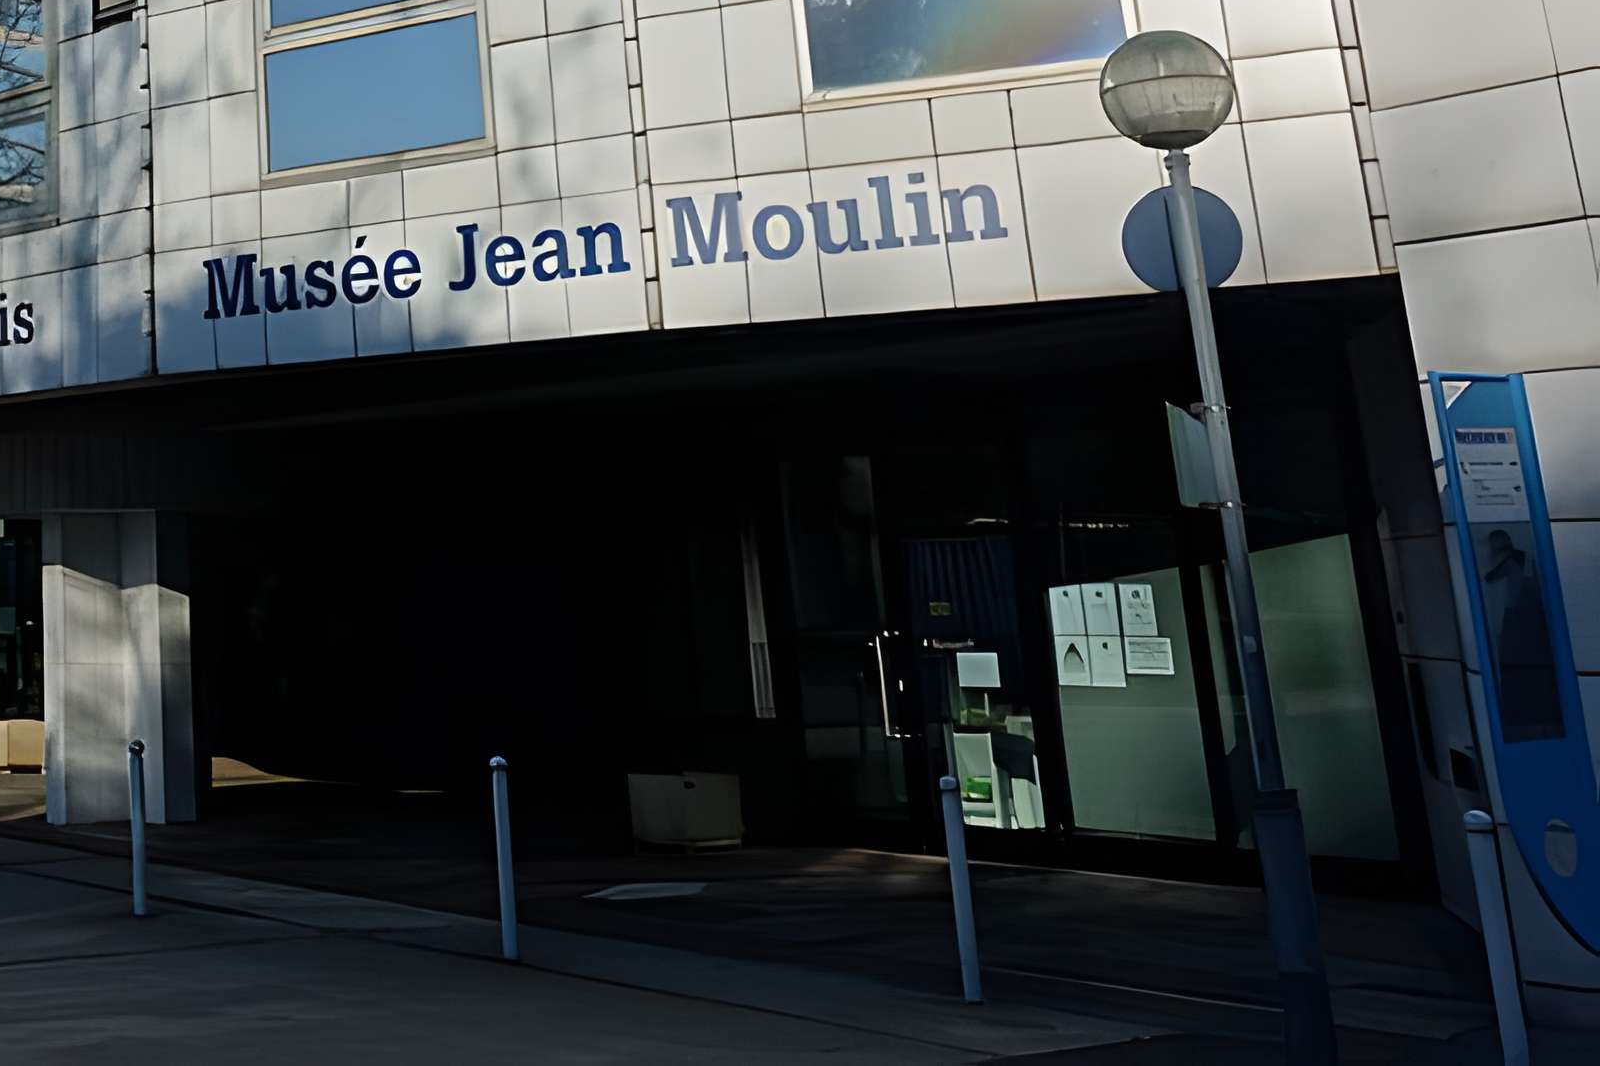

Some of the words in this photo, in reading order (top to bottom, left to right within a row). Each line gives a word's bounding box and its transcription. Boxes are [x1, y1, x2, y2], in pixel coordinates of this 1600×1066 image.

[203, 235, 423, 320] Musée
[448, 221, 631, 292] Jean
[666, 172, 1008, 268] Moulin
